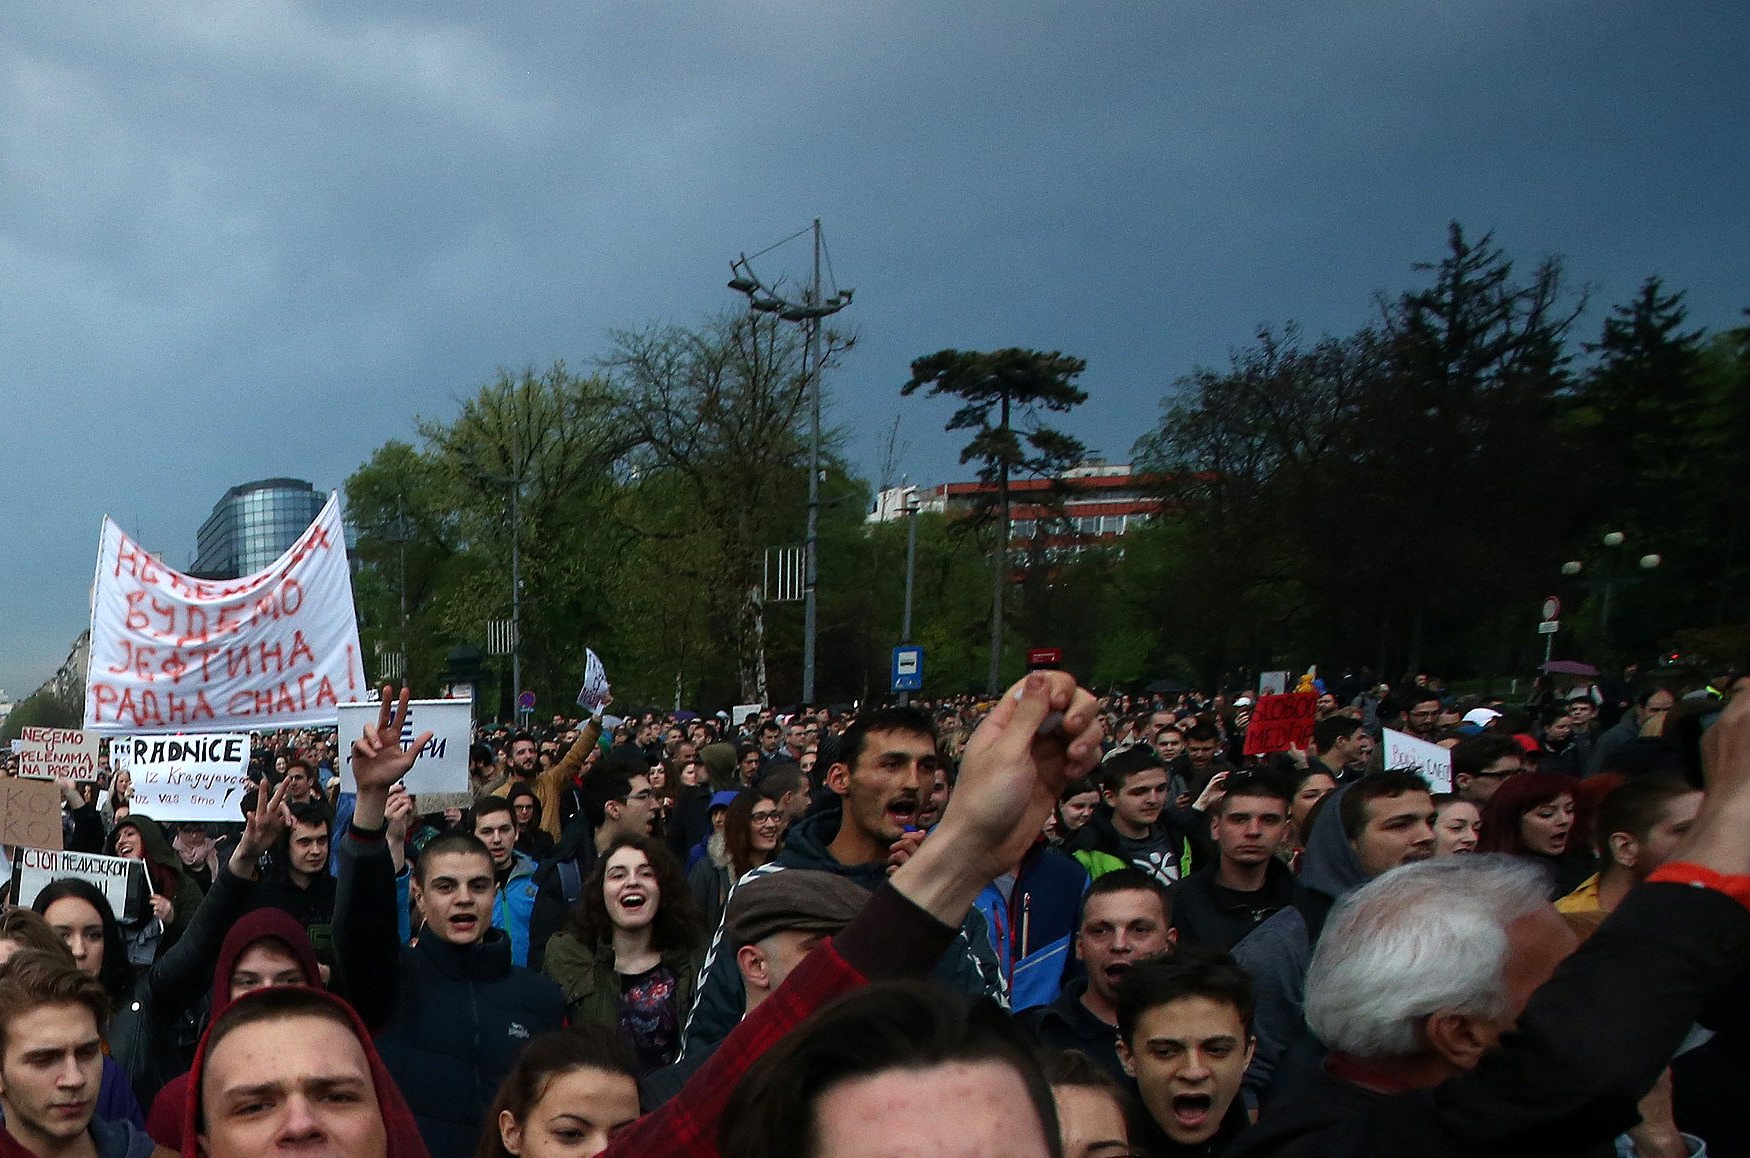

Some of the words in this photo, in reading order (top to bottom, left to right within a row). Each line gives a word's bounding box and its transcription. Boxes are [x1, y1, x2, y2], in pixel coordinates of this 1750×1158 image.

[126, 577, 303, 648] БУДЕМО
[92, 682, 216, 727] РАДНА
[22, 764, 41, 776] NA
[24, 850, 58, 872] СТОП
